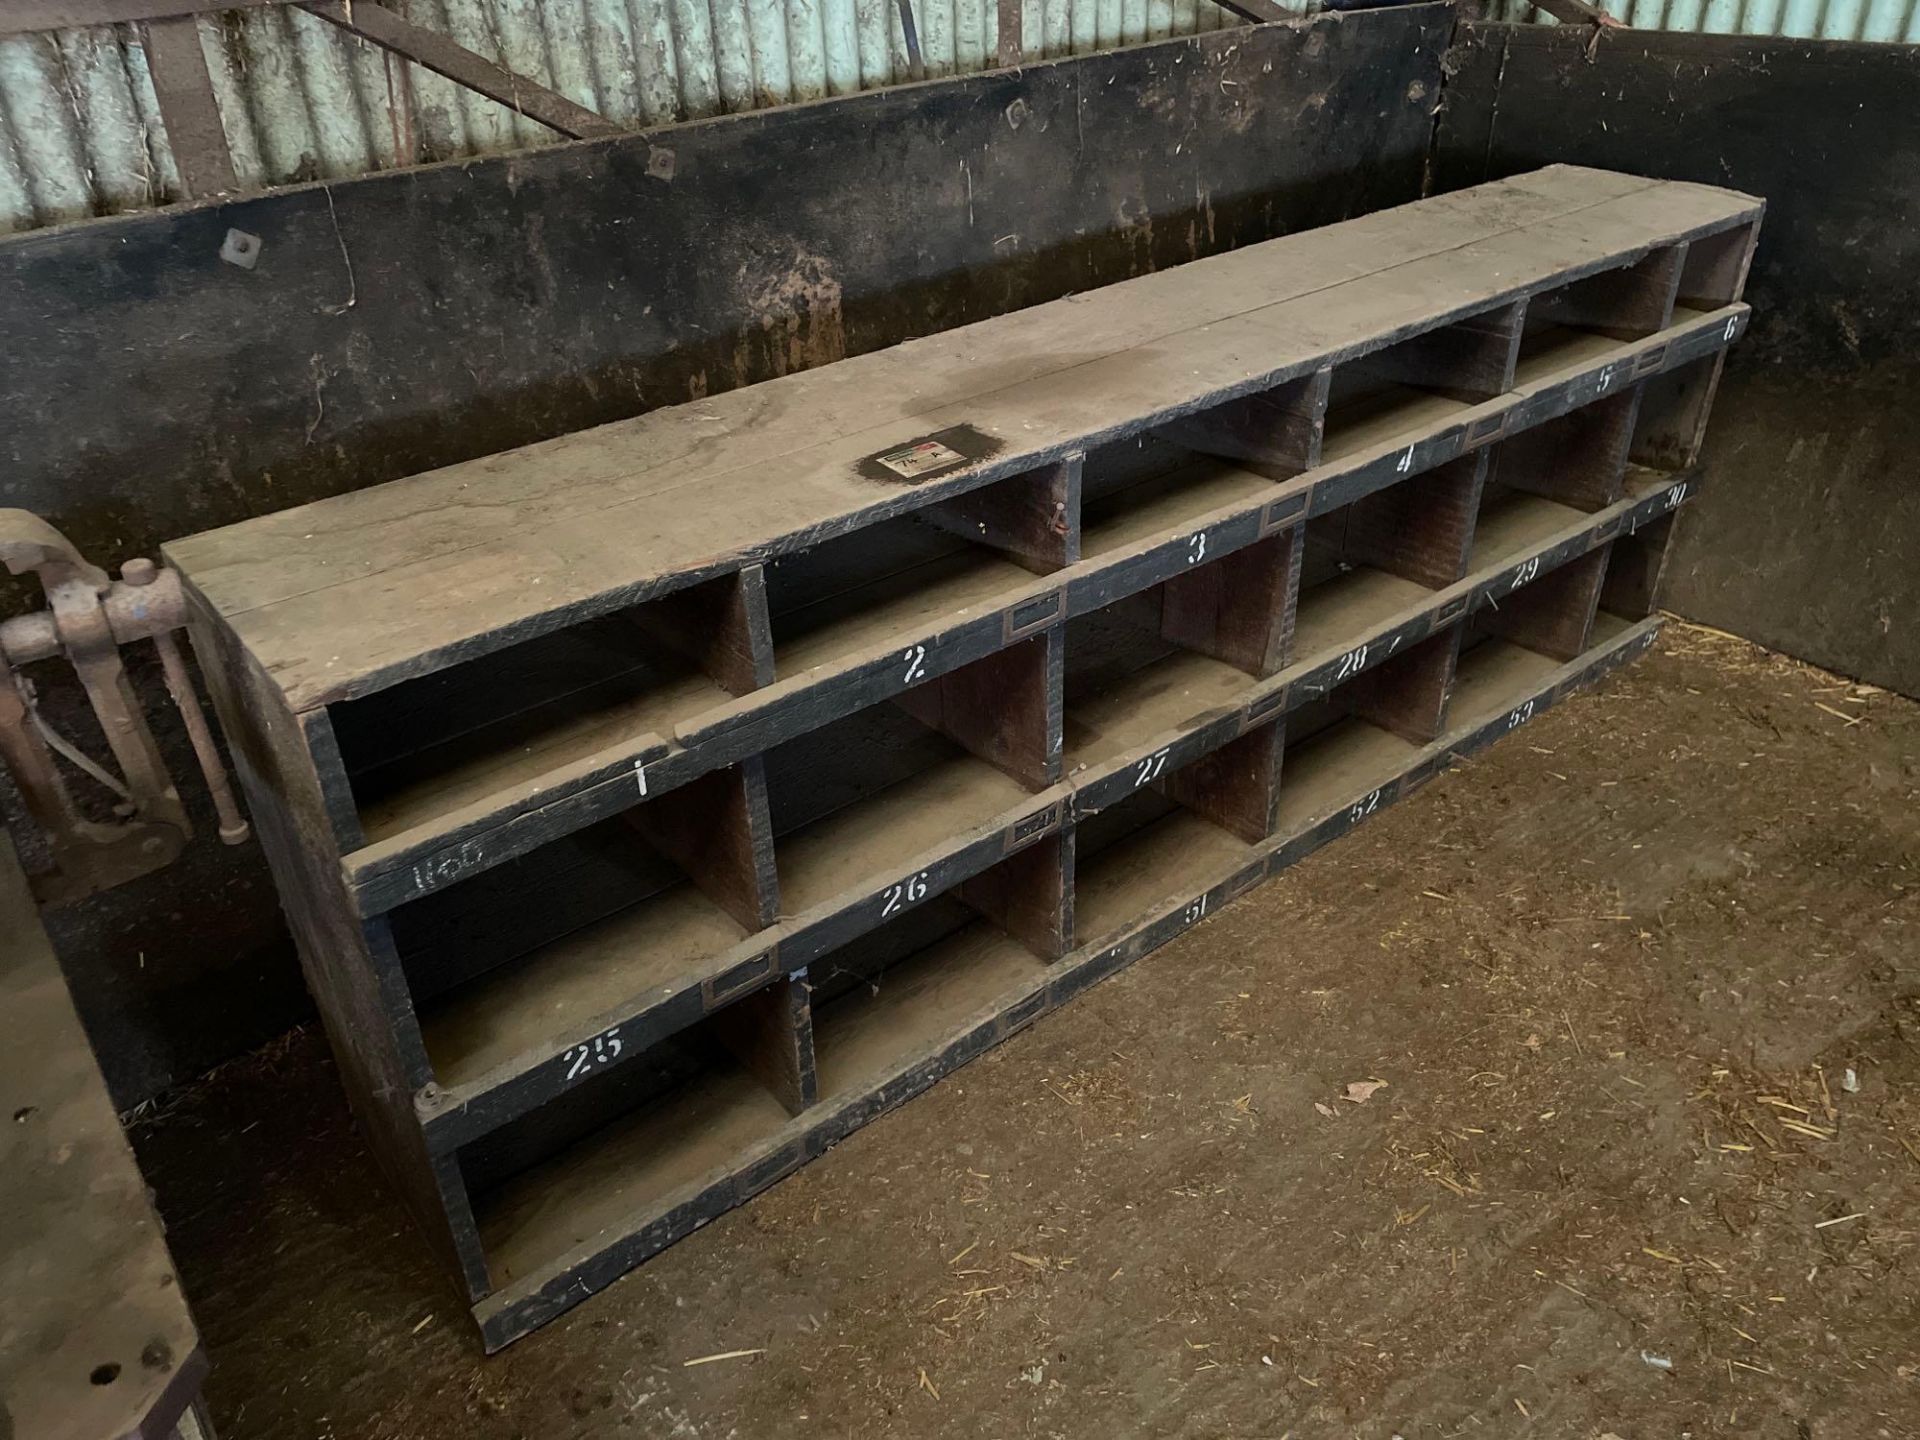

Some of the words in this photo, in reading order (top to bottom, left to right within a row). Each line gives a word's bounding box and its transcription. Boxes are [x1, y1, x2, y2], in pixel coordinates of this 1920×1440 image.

[1724, 316, 1738, 341] 6
[1597, 366, 1613, 393] 5
[1189, 534, 1204, 562] 3
[1511, 557, 1538, 588] 29
[904, 646, 924, 682] 2
[1509, 700, 1533, 728] 53
[636, 760, 647, 796] 1
[1135, 747, 1169, 786] 27
[1351, 789, 1381, 822] 52
[882, 872, 929, 918] 26
[1184, 894, 1207, 924] 51
[564, 1031, 622, 1080] 25
